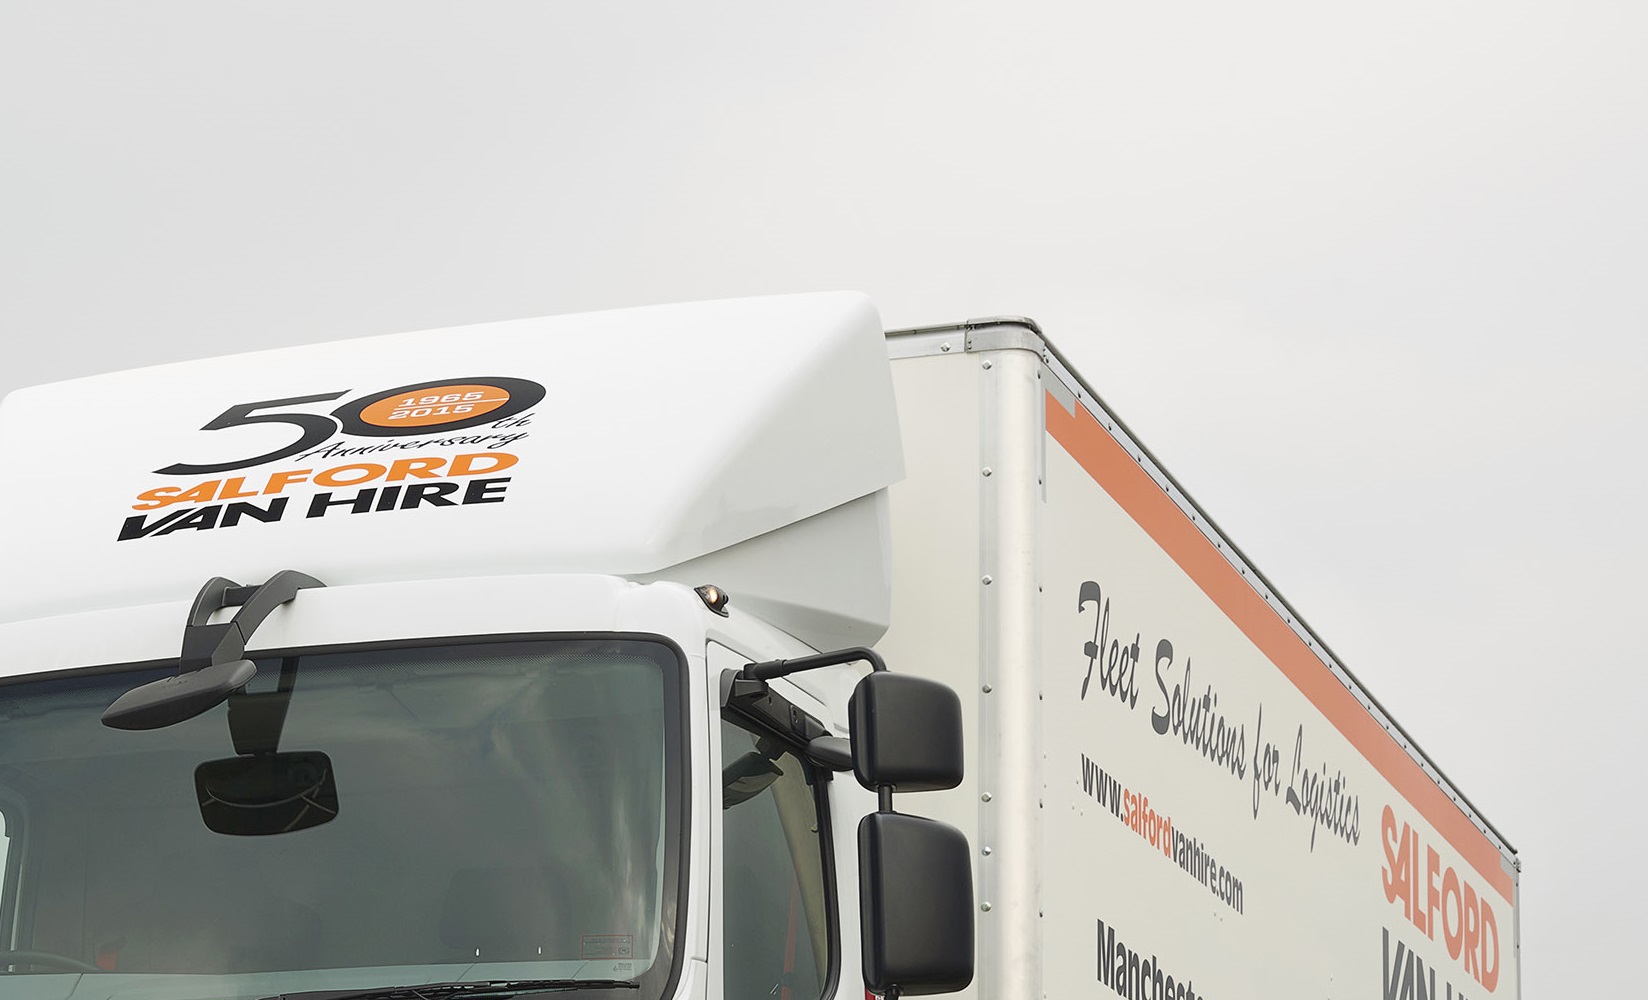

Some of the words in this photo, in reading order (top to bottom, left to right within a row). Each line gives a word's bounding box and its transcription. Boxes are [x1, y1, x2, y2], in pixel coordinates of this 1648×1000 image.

[387, 404, 474, 420] 2015
[398, 390, 484, 407] 1965
[295, 432, 529, 462] Anniversary
[117, 497, 289, 541] VAN
[306, 477, 511, 518] HIRE
[132, 452, 519, 511] SALFORD
[1078, 581, 1140, 709] Fleet
[1152, 639, 1246, 780] Solutions
[1252, 703, 1280, 820] for
[1286, 724, 1360, 852] Logistics
[1081, 753, 1243, 915] www.salfordvanhire.com
[1382, 804, 1499, 992] SALFORD
